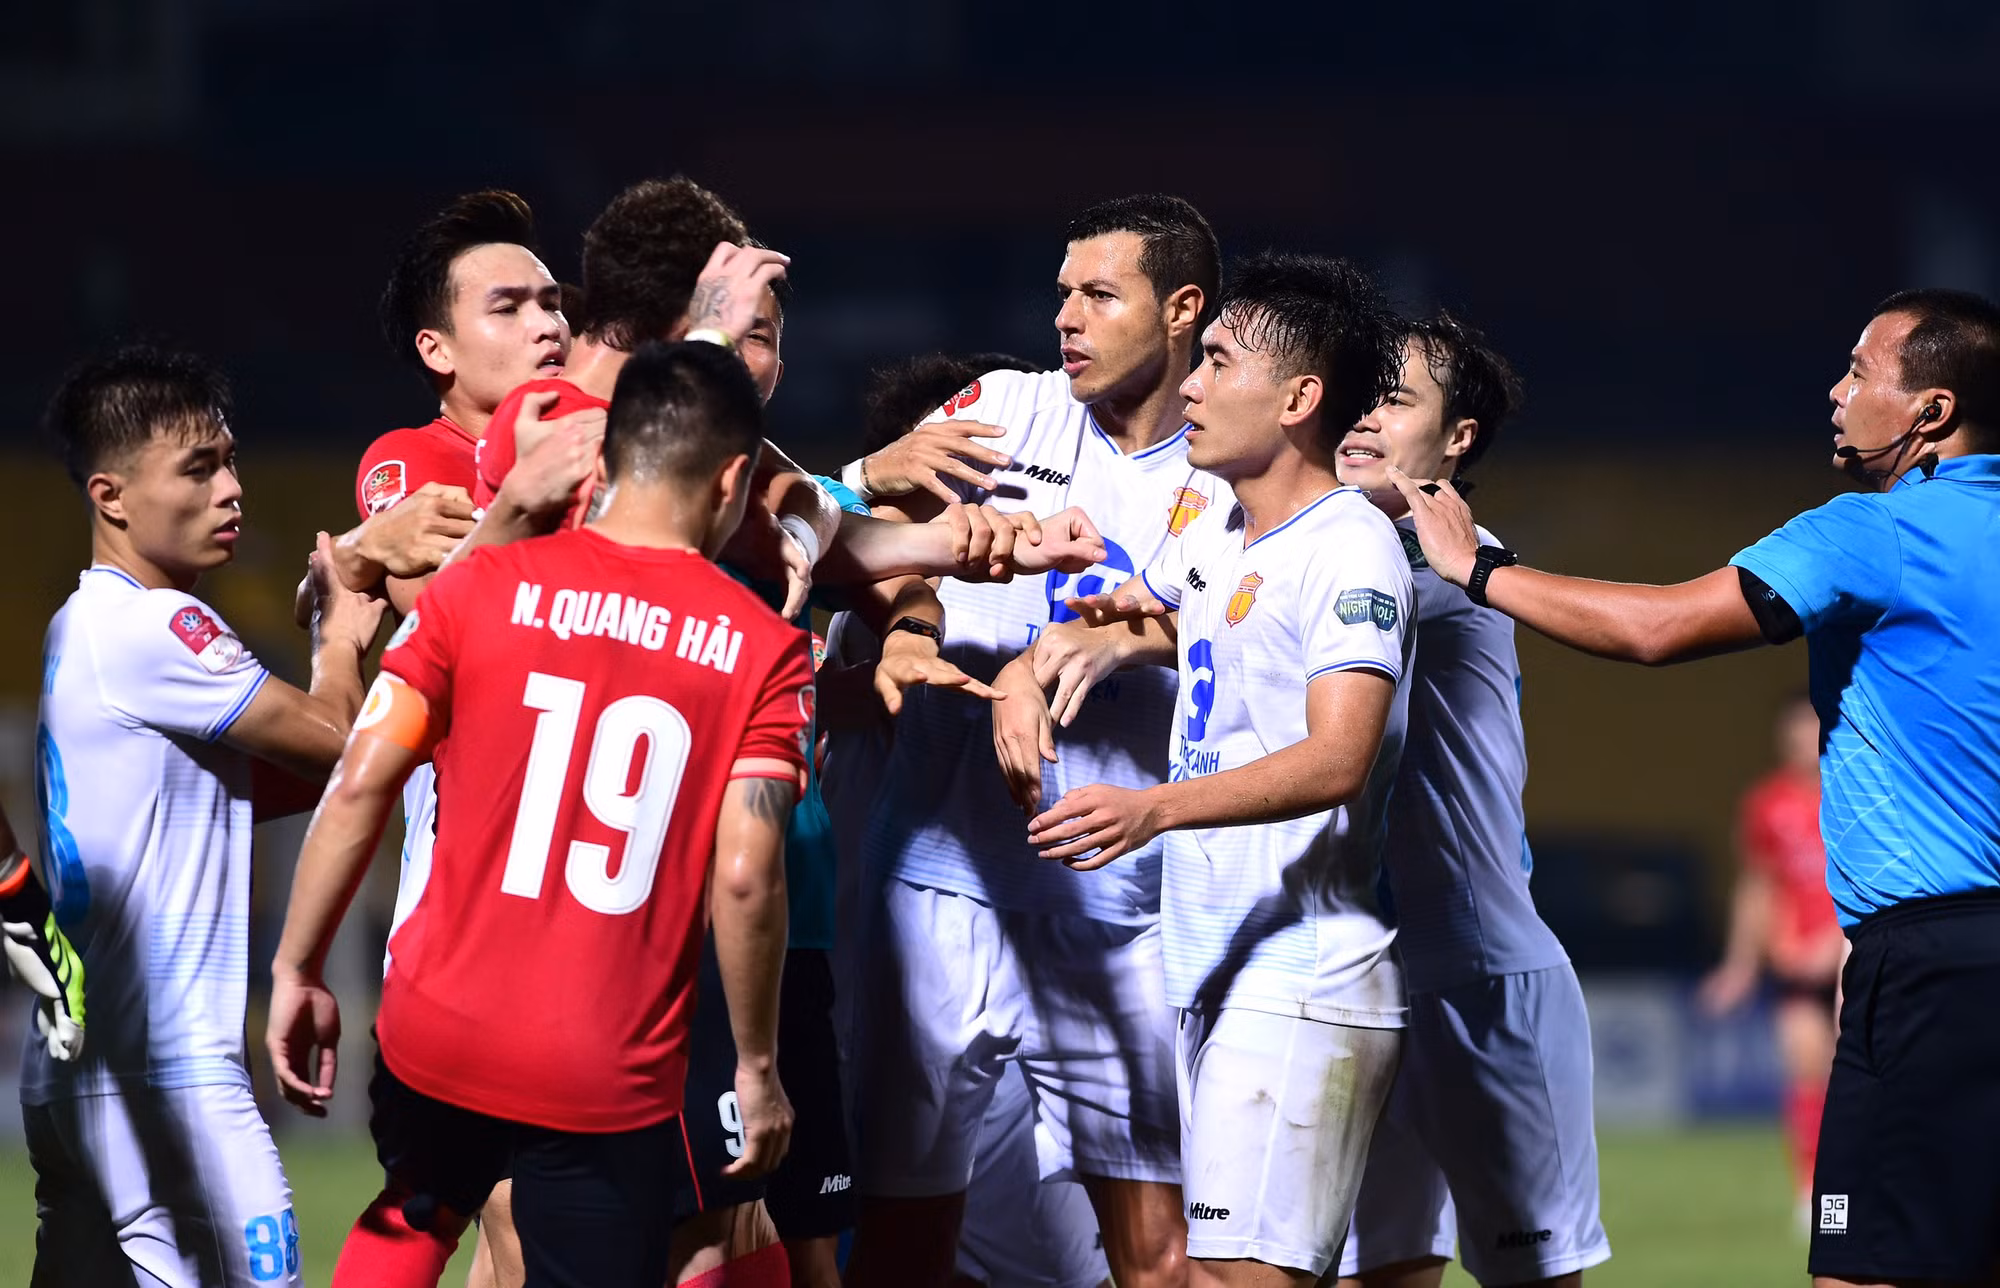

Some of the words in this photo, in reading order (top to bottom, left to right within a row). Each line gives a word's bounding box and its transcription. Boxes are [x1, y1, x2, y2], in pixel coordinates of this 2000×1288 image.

[1340, 599, 1372, 622] NIGHT
[1374, 603, 1395, 624] WOLF
[675, 614, 744, 675] HẢI
[501, 671, 692, 915] 19
[1189, 1201, 1230, 1220] Mitre
[1822, 1212, 1844, 1225] BL
